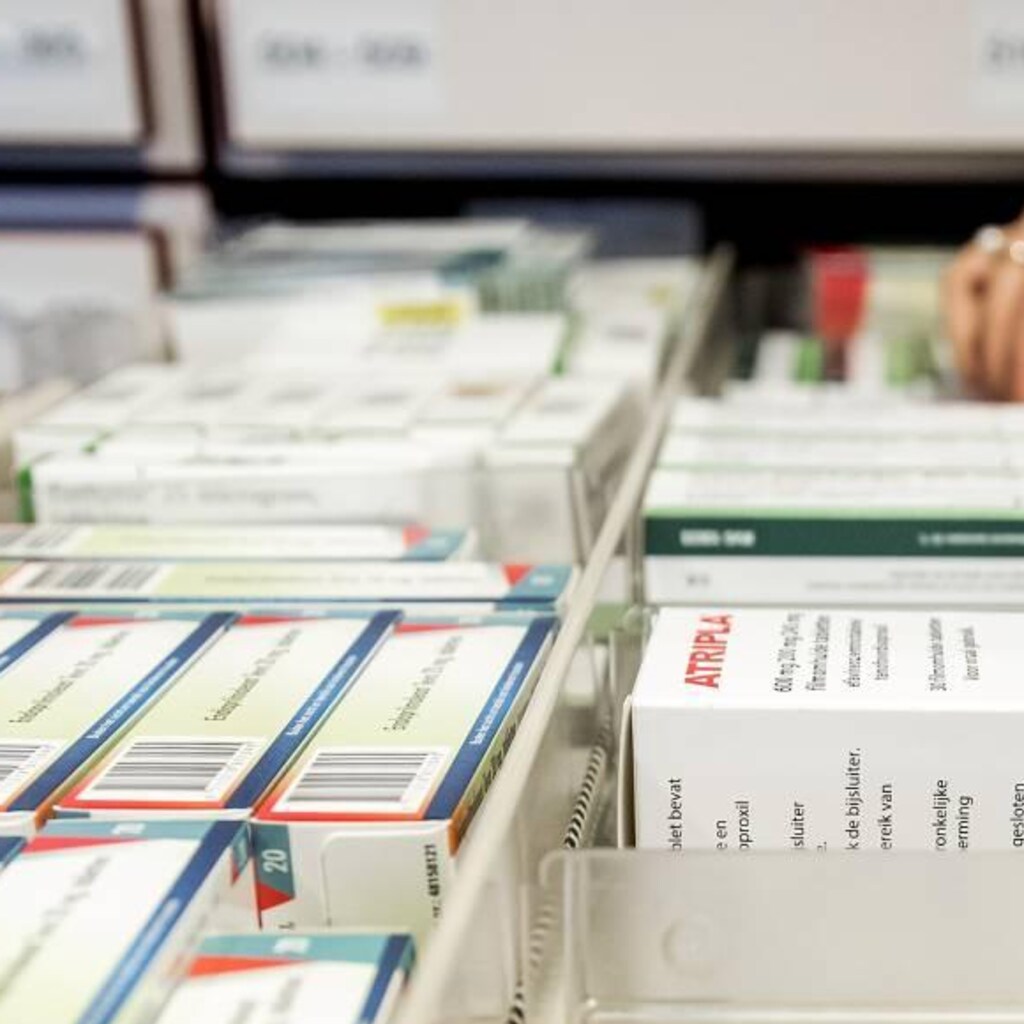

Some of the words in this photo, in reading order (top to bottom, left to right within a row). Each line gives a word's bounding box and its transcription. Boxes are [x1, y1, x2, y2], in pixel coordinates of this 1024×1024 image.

[685, 613, 735, 689] ATRIPLA
[774, 677, 793, 692] 600
[845, 748, 863, 816] bijsluiter.
[668, 778, 682, 820] bevat
[881, 784, 892, 811] van
[716, 819, 728, 839] en
[845, 820, 859, 839] de
[261, 849, 288, 873] 20
